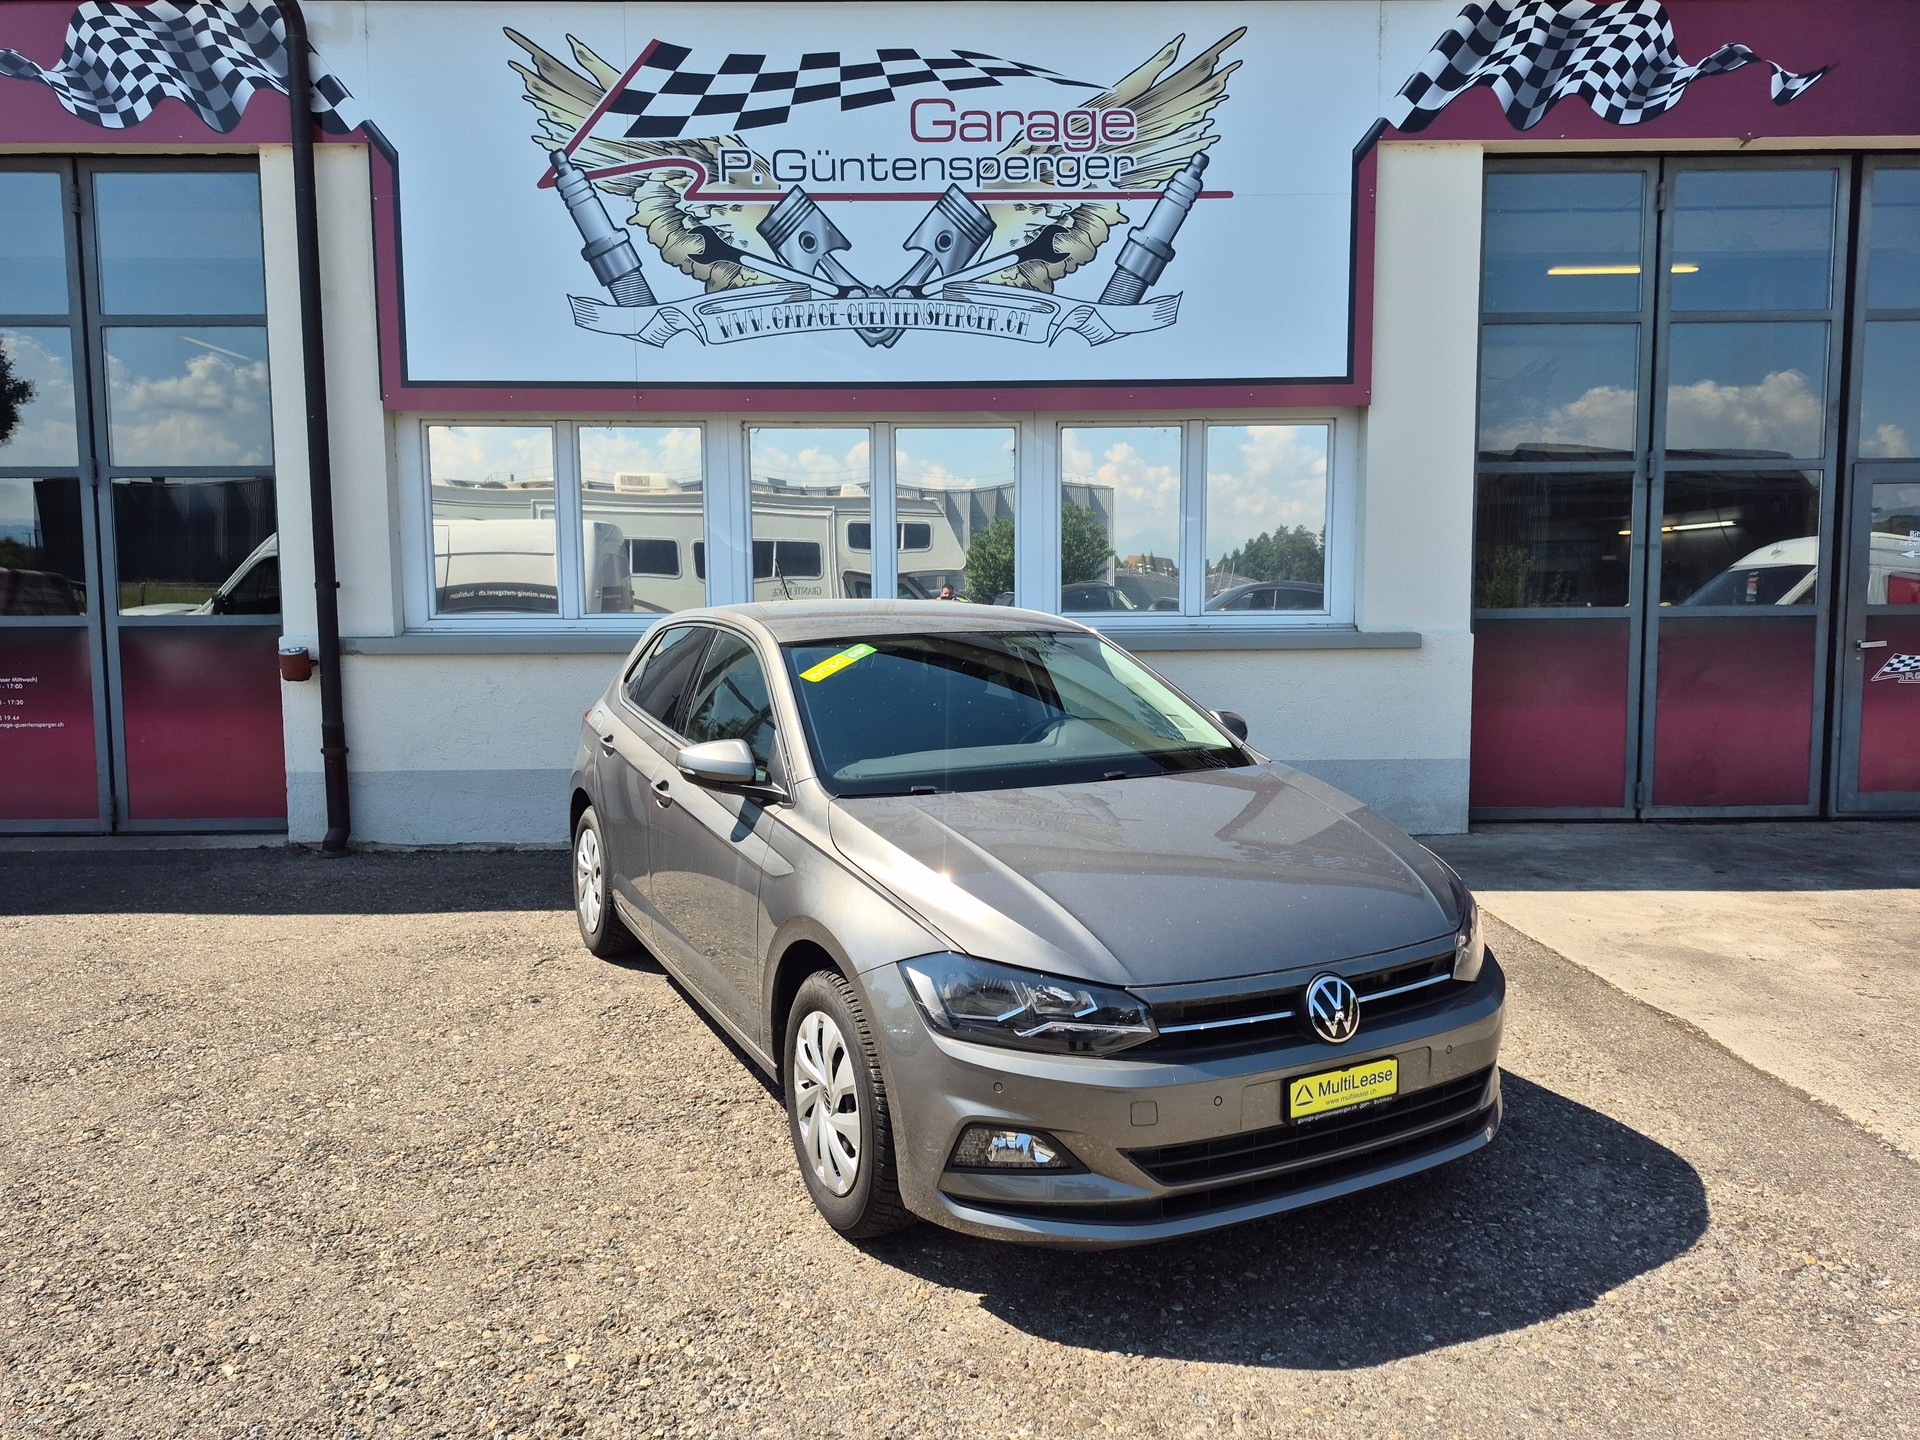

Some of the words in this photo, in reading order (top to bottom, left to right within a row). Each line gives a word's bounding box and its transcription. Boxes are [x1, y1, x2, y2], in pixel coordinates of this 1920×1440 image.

[910, 98, 1135, 152] Garage
[715, 302, 1032, 339] WWW.GARAGE-GUENTENSPERGER.CH
[808, 658, 847, 680] sympa
[848, 646, 868, 658] car
[1318, 1069, 1393, 1098] MultiLease
